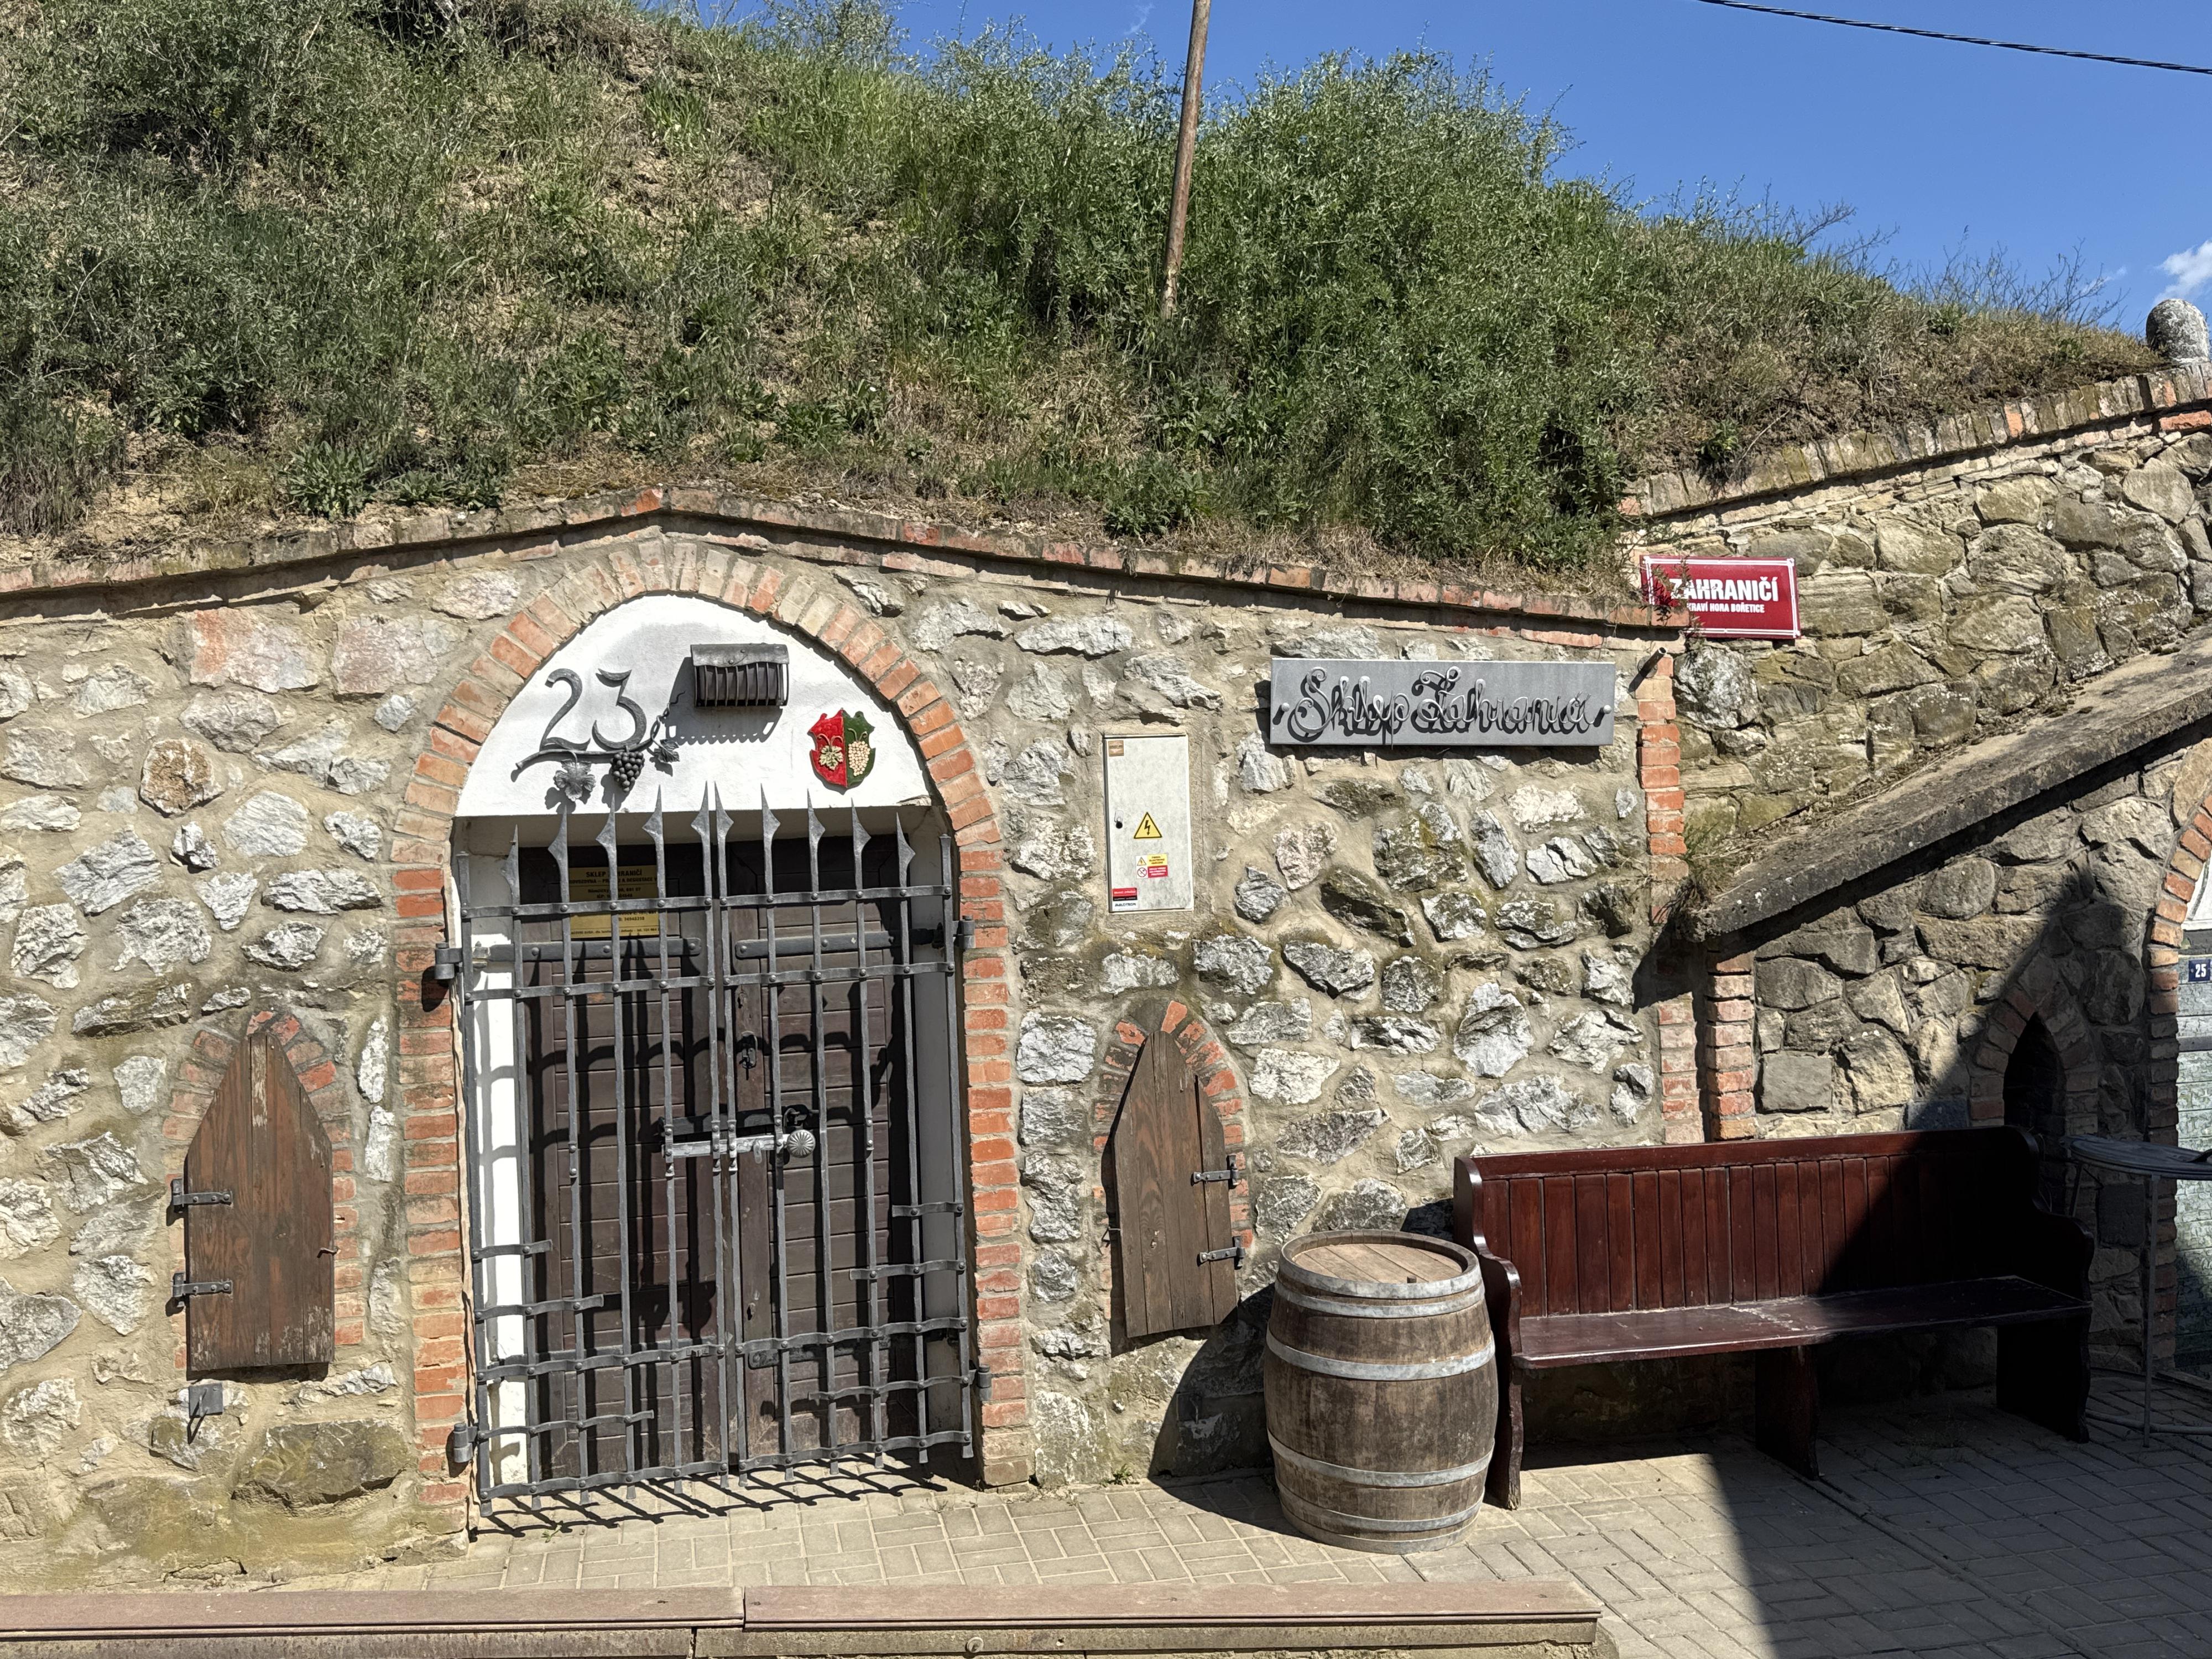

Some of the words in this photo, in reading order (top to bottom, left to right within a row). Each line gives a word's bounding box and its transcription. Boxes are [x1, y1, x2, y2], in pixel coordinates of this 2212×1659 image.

[1669, 576, 1778, 602] ZAHRANIČÍ
[1710, 603, 1729, 612] HORA
[539, 667, 647, 752] 23
[1295, 666, 1410, 750] Sklep
[2195, 963, 2206, 978] 25
